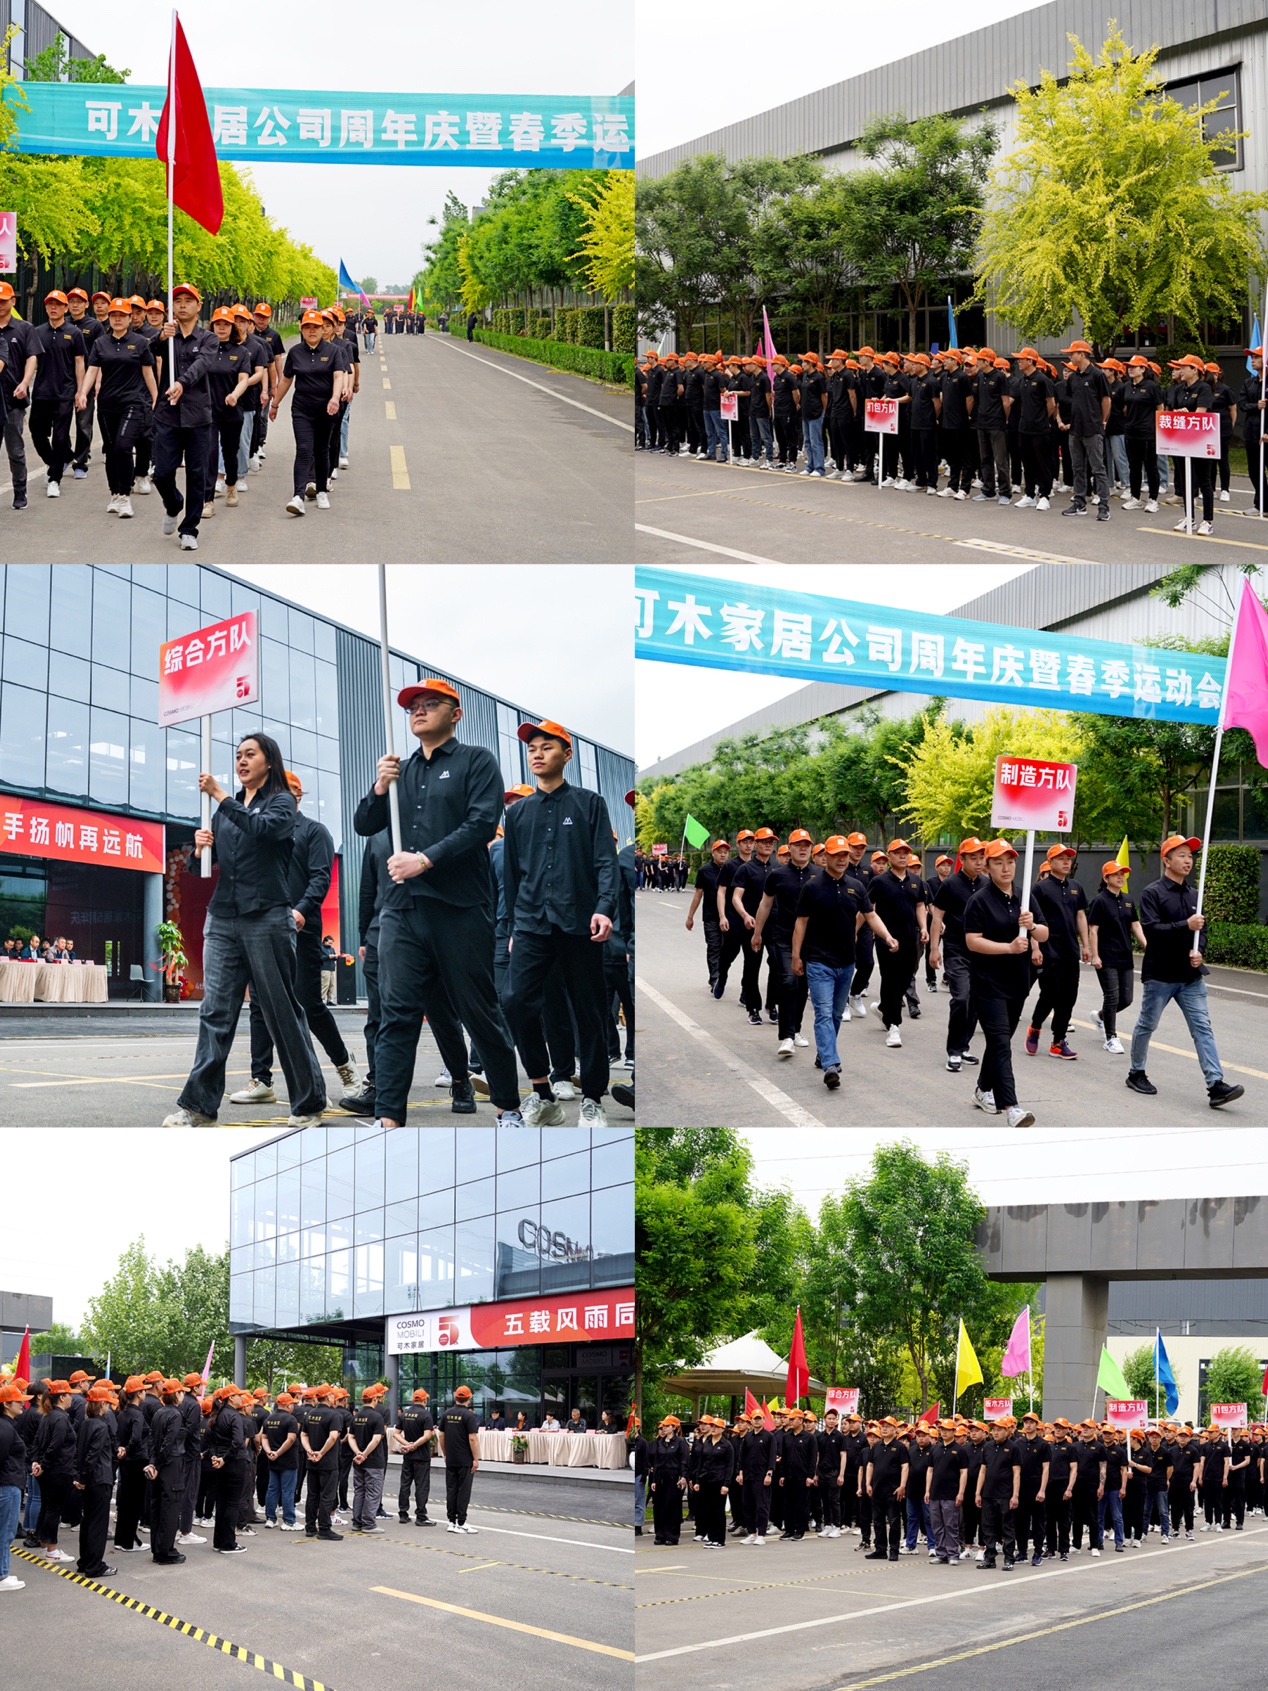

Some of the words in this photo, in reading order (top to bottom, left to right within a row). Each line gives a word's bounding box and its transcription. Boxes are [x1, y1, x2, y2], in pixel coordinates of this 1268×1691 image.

[85, 101, 630, 152] 可木居公司周年庆暨春季运
[1159, 415, 1216, 431] 裁缝方队
[164, 621, 251, 675] 综合方队
[635, 587, 1222, 709] 可木家居公司周年庆暨春季运动会
[1001, 763, 1072, 791] 制造方队
[3, 812, 143, 859] 手扬帆再远航
[397, 1319, 425, 1329] COSMO
[504, 1302, 635, 1336] 五载风雨同
[397, 1329, 424, 1338] MOBILI
[397, 1340, 424, 1350] 可木家居
[1109, 1403, 1145, 1412] 制造方队
